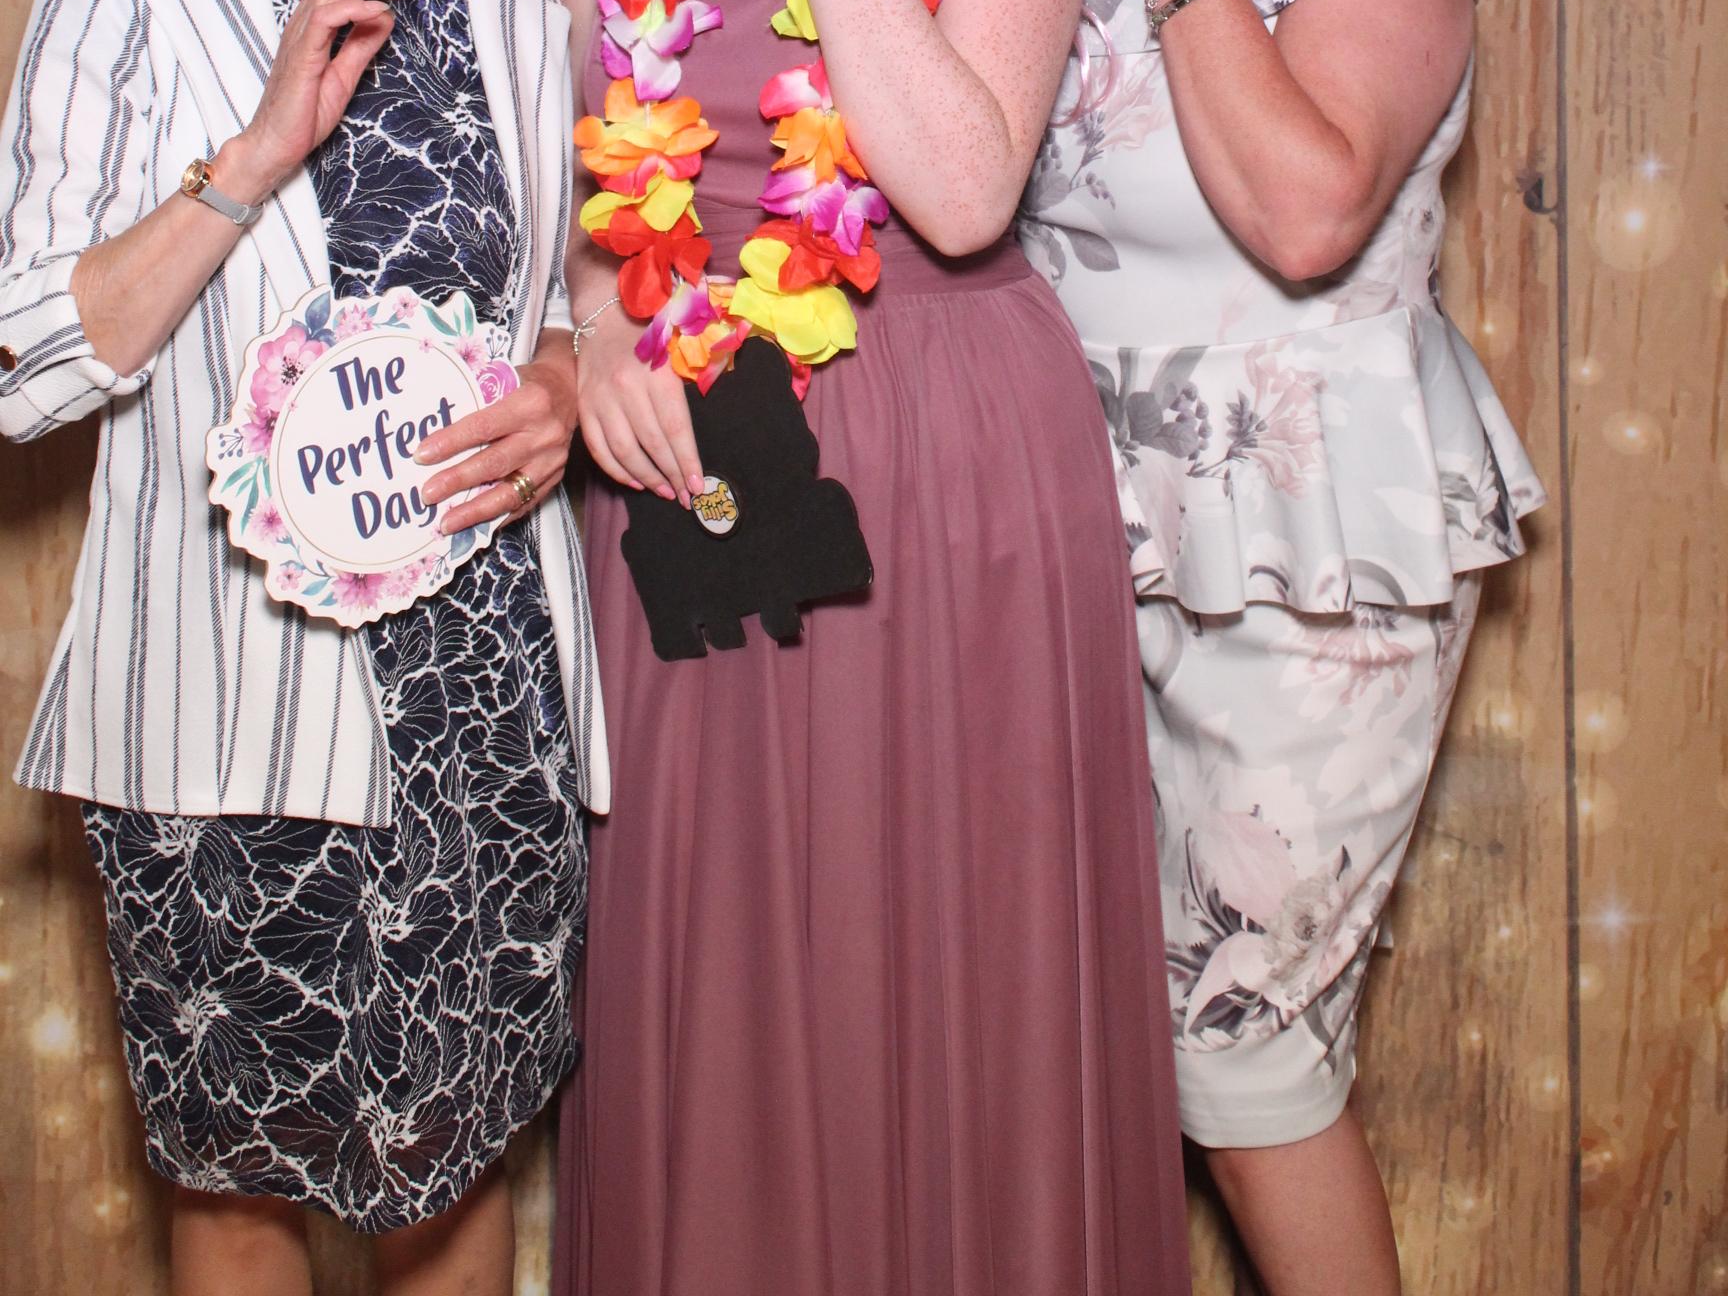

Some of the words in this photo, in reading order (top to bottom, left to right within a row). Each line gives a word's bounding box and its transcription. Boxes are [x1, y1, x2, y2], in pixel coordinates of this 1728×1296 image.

[329, 356, 406, 411] The
[297, 396, 457, 495] Perfect
[351, 485, 438, 540] Day
[701, 499, 737, 521] Silly
